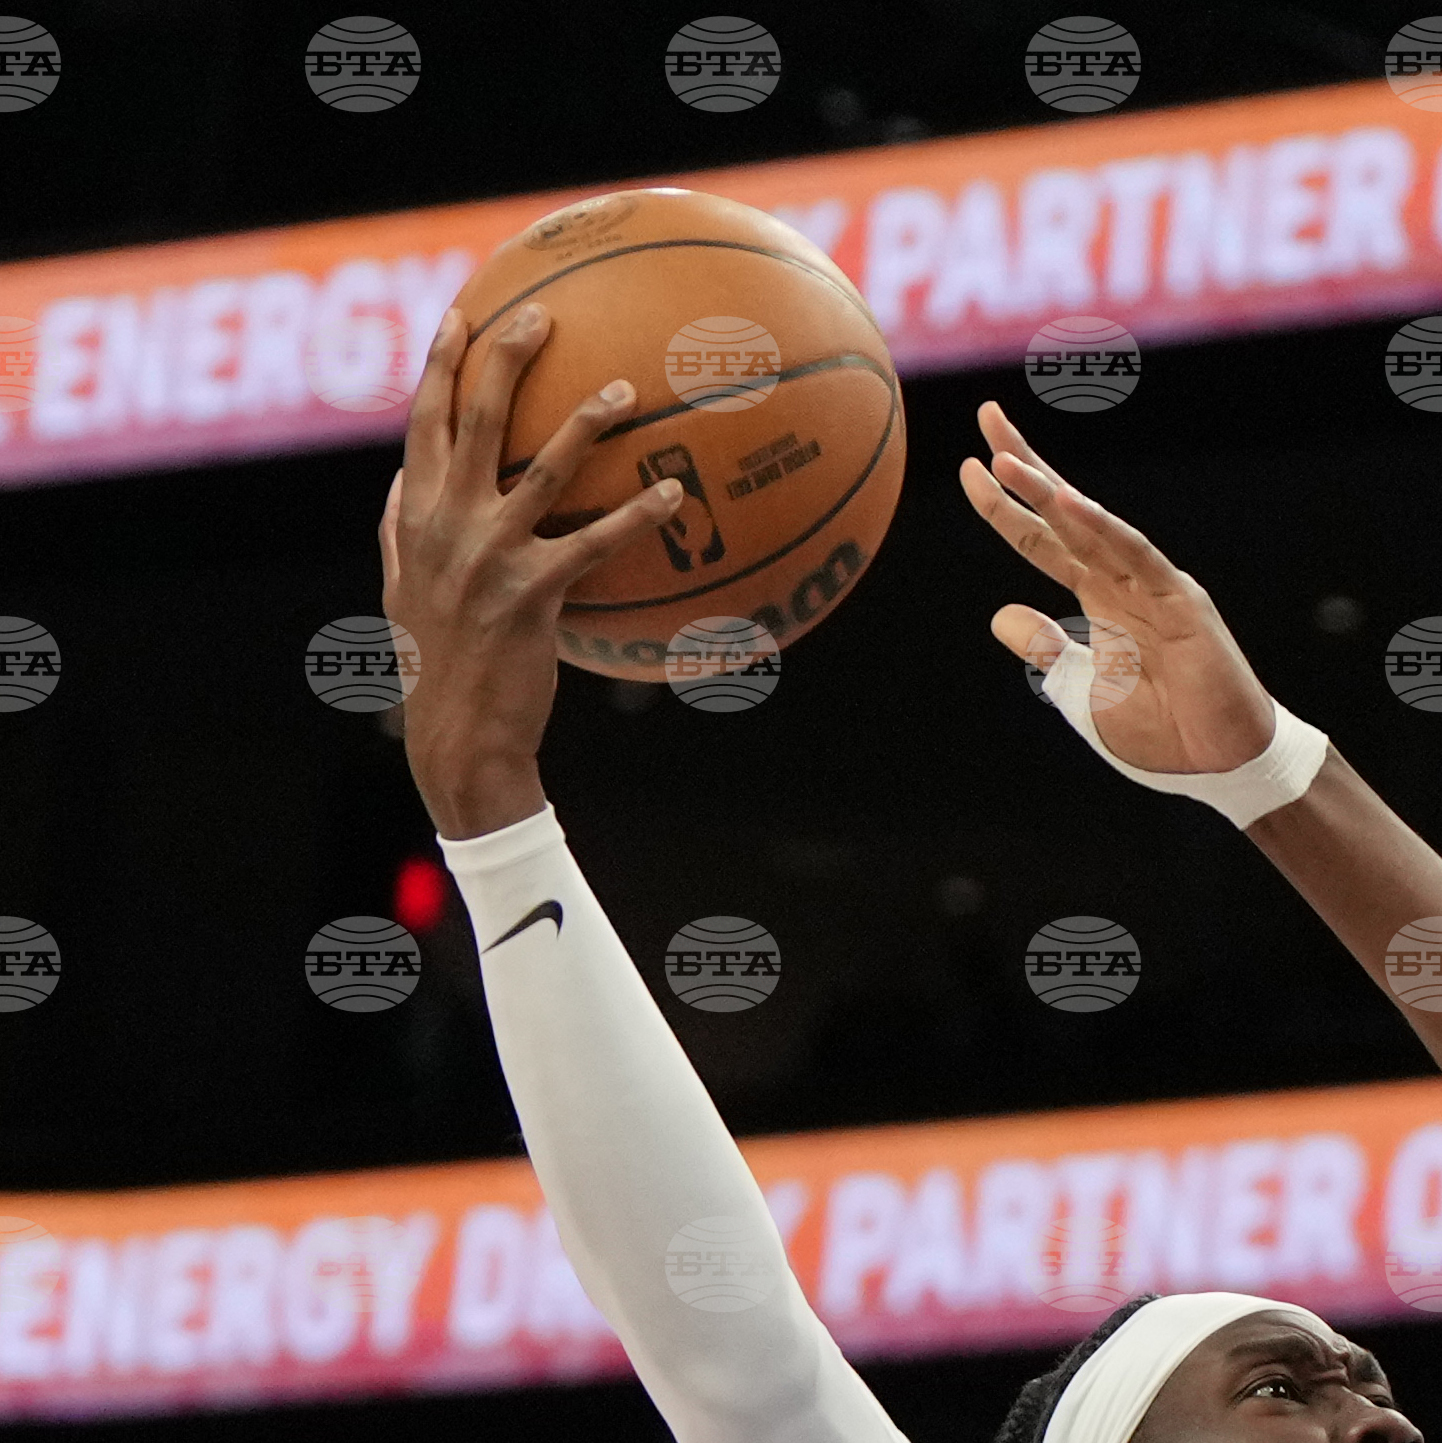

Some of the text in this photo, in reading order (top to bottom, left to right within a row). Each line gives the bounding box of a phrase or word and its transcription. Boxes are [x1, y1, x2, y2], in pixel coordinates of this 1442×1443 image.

[30, 248, 477, 442] ENERGY
[862, 126, 1416, 331] PARTNER
[0, 1211, 440, 1378] ENERGY
[818, 1132, 1366, 1318] PARTNER
